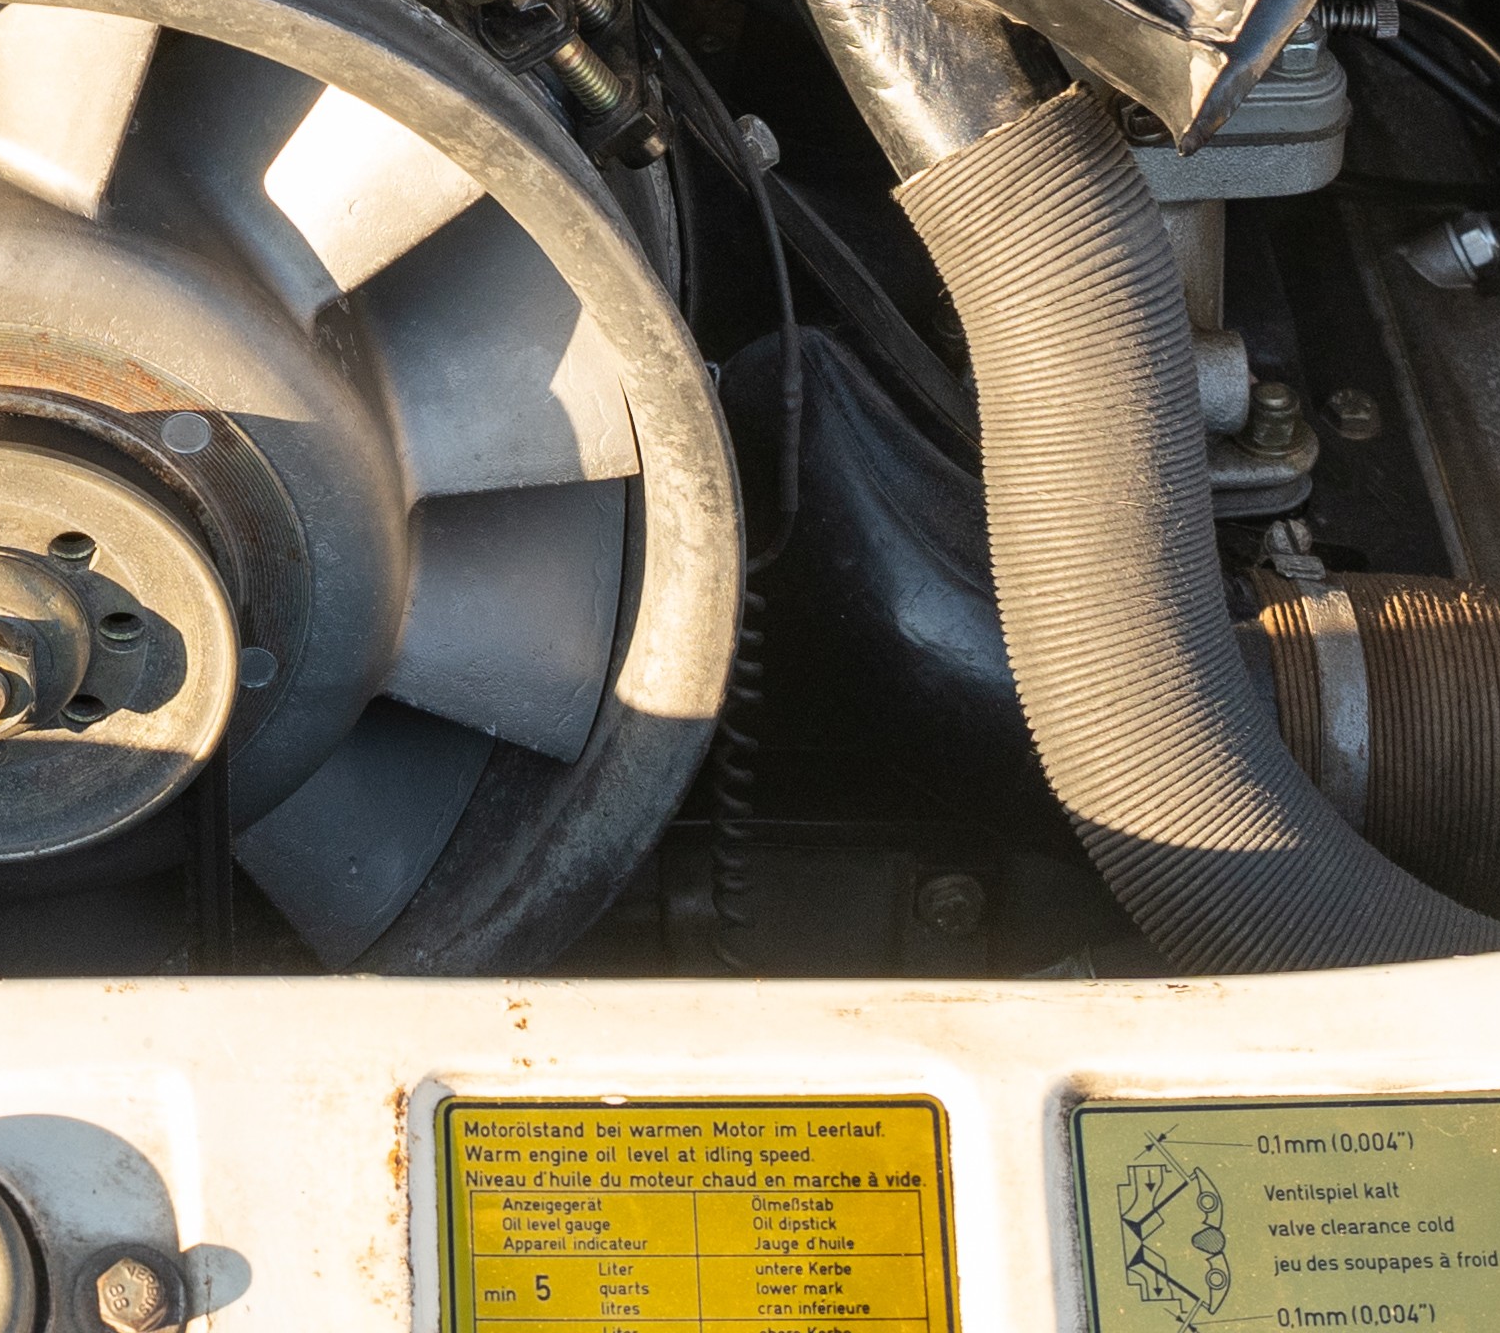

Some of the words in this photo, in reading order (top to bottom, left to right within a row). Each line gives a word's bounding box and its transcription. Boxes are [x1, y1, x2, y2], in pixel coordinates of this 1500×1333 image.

[464, 1120, 584, 1138] Motorölstand
[596, 1121, 622, 1138] bei
[629, 1125, 703, 1138] warmen
[712, 1121, 766, 1138] Motor
[774, 1121, 797, 1138] im
[807, 1120, 885, 1138] Leerlauf.
[464, 1145, 522, 1163] Warm
[529, 1145, 589, 1167] engine
[596, 1145, 617, 1163] oil
[627, 1146, 669, 1163] level
[677, 1146, 697, 1163] at
[705, 1145, 753, 1167] idling
[759, 1146, 815, 1167] speed.
[465, 1169, 526, 1188] Niveau
[600, 1171, 622, 1188] du
[629, 1171, 695, 1188] moteur
[702, 1170, 757, 1188] chaud
[764, 1175, 786, 1188] en
[793, 1171, 862, 1188] marche
[867, 1171, 879, 1188] à
[885, 1170, 927, 1188] vide.
[1263, 1182, 1359, 1205] Ventilspiel
[1363, 1181, 1400, 1199] kalt
[502, 1197, 603, 1216] Anzeigegerät
[751, 1194, 834, 1212] Ölmeßstab
[502, 1216, 522, 1231] Oil
[526, 1217, 561, 1232] level
[564, 1220, 611, 1235] gauge
[752, 1216, 774, 1231] Oil
[778, 1216, 837, 1234] dipstick
[1267, 1219, 1316, 1237] valve
[1320, 1218, 1411, 1236] clearance
[1417, 1215, 1455, 1233] cold
[502, 1235, 567, 1254] Appareil
[573, 1236, 649, 1251] indicateur
[753, 1236, 800, 1254] Jauge
[598, 1262, 634, 1277] Liter
[755, 1261, 804, 1276] untere
[808, 1261, 852, 1276] Kerbe
[1274, 1255, 1302, 1277] jeu
[1306, 1254, 1339, 1272] des
[1343, 1256, 1434, 1275] soupapes
[1439, 1252, 1451, 1269] à
[1456, 1249, 1499, 1268] froid
[484, 1285, 517, 1302] min
[535, 1274, 551, 1302] 5
[599, 1281, 650, 1299] quarts
[756, 1282, 798, 1295] lower
[803, 1281, 844, 1295] mark
[600, 1301, 641, 1316] litres
[757, 1304, 793, 1315] cran
[798, 1298, 871, 1316] inférieure
